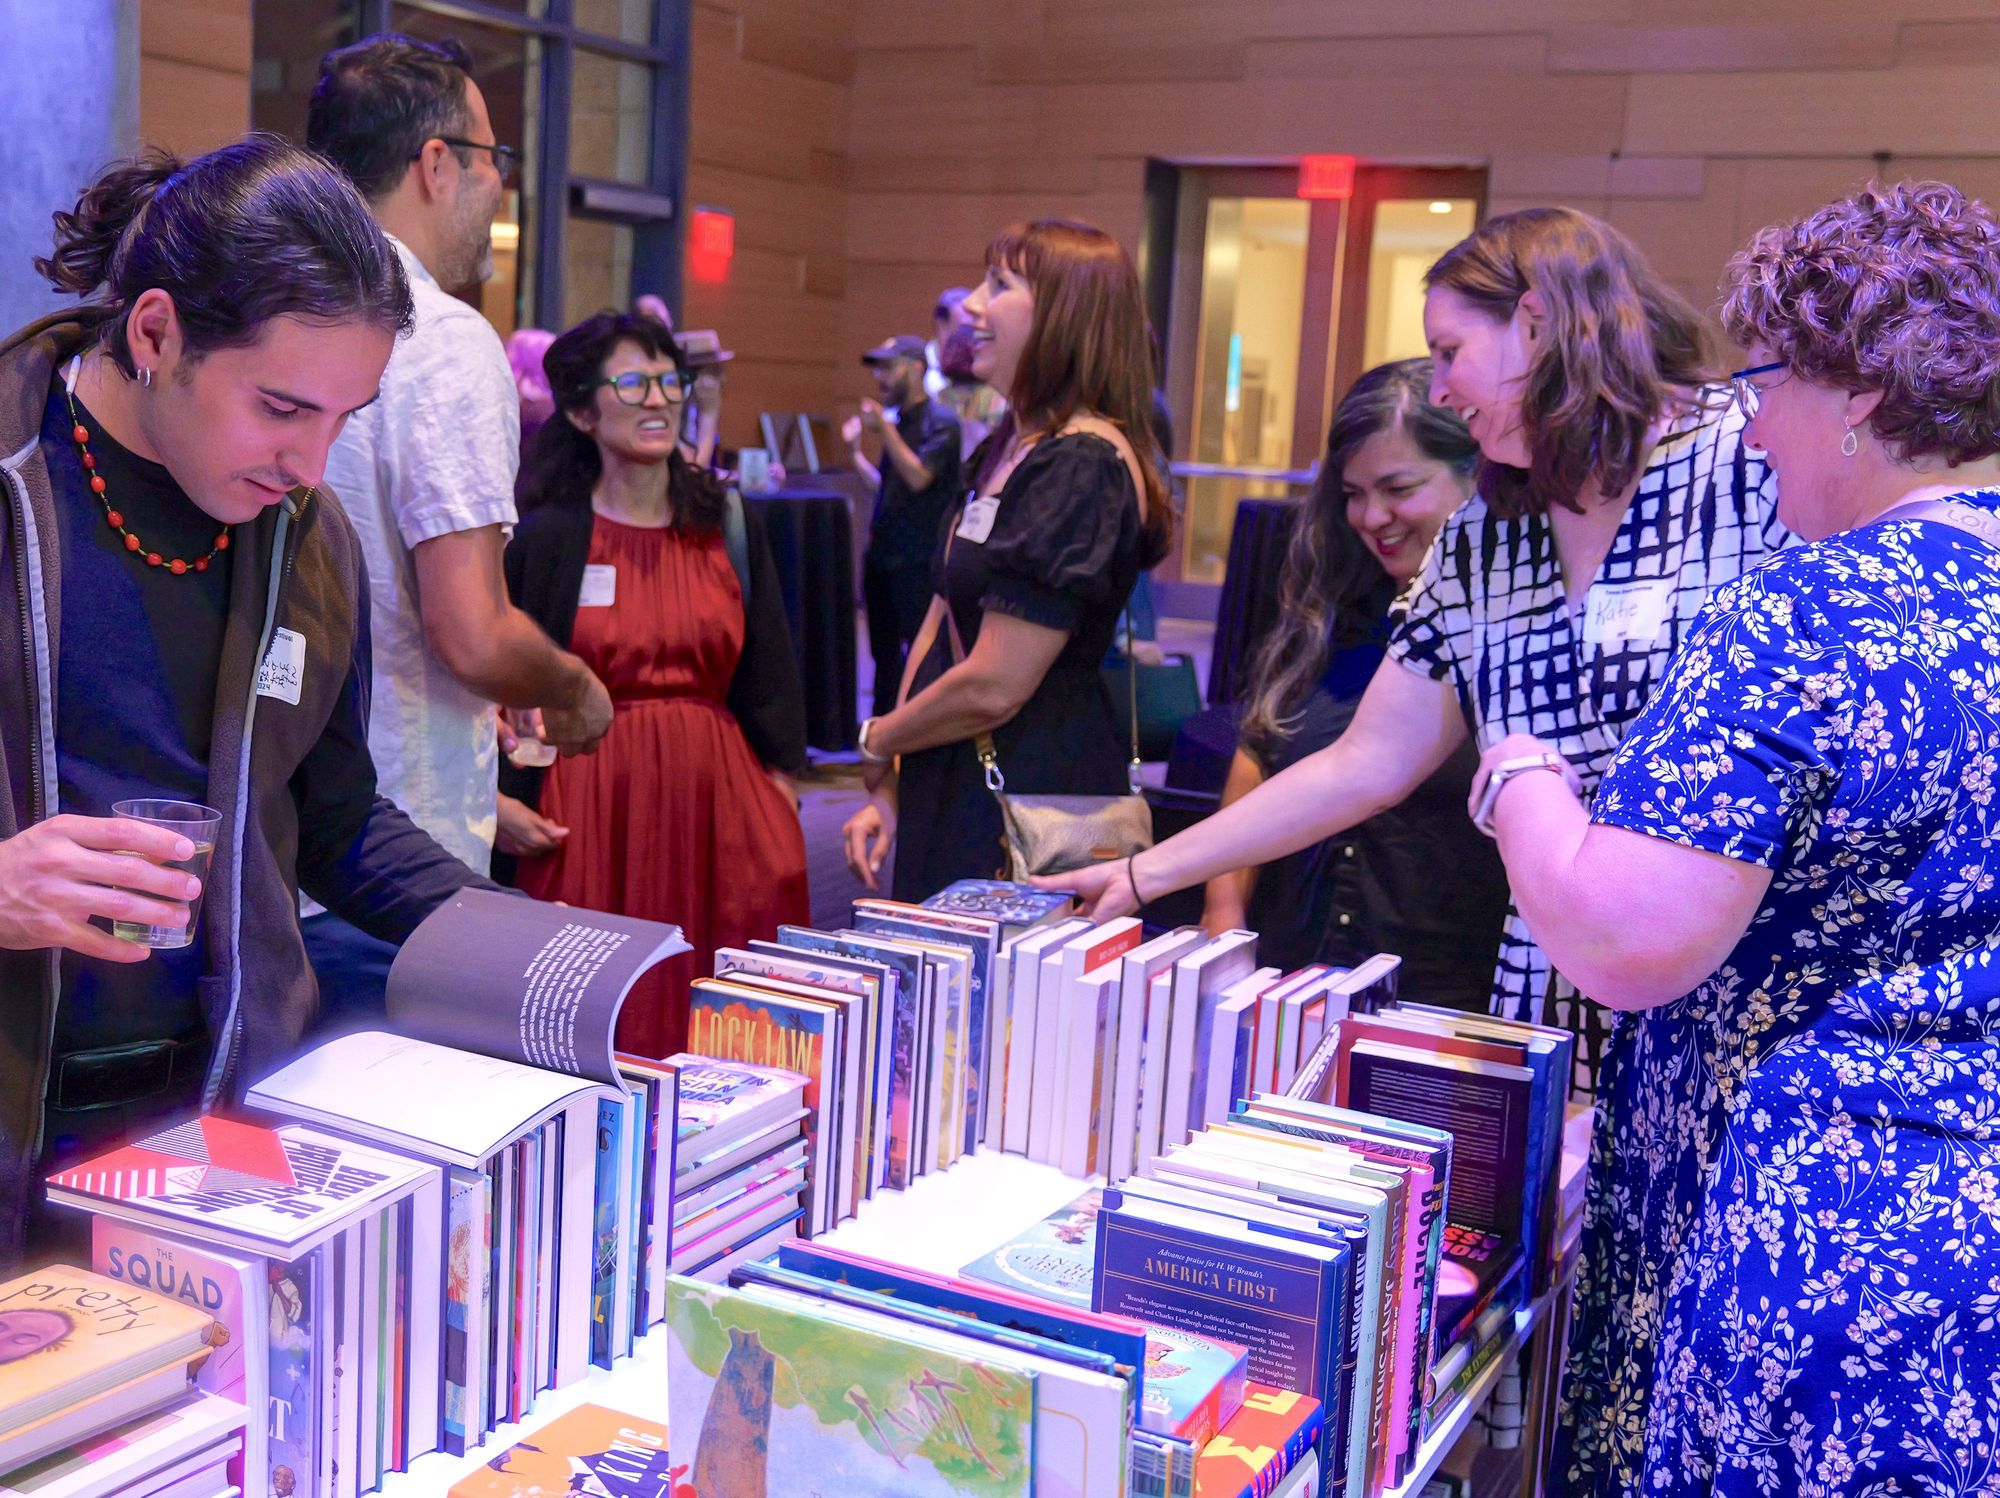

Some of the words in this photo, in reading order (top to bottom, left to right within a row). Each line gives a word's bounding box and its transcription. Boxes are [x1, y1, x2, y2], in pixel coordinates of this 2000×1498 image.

[1595, 598, 1638, 626] Katie
[528, 972, 541, 989] more
[539, 973, 551, 987] that
[581, 971, 597, 988] know
[523, 989, 532, 1006] than
[534, 988, 544, 1000] has
[542, 987, 553, 1007] equal
[552, 982, 568, 1010] because
[561, 993, 573, 1009] they
[573, 989, 585, 1004] why
[530, 1001, 539, 1022] fallen
[540, 1008, 547, 1017] to
[550, 1012, 556, 1020] us
[568, 1005, 578, 1022] they
[558, 1013, 566, 1042] oppress
[540, 1040, 545, 1050] An
[548, 1028, 556, 1055] greater
[693, 1008, 814, 1076] LOCKJAW
[542, 1051, 552, 1067] equal
[552, 1056, 561, 1069] than
[680, 1079, 739, 1094] SIAN
[681, 1068, 741, 1082] ADE
[741, 1076, 772, 1087] IN
[679, 1089, 736, 1105] RICA
[318, 1165, 391, 1200] BOOK
[262, 1199, 325, 1220] OF
[1413, 1192, 1432, 1289] DOCILE
[157, 1247, 173, 1261] THE
[1158, 1249, 1185, 1260] Advance
[1185, 1256, 1205, 1265] praise
[1204, 1259, 1215, 1268] for
[1216, 1262, 1225, 1270] H.
[1226, 1264, 1235, 1273] W.
[1236, 1267, 1263, 1279] Brands's
[108, 1246, 223, 1310] SQUAD
[1144, 1257, 1220, 1289] AMERICA
[1228, 1277, 1278, 1303] FIRST
[3, 1281, 158, 1336] pretty
[1380, 1279, 1395, 1346] JANE
[1120, 1302, 1144, 1313] Roosevelt
[1155, 1310, 1174, 1320] Charles
[1175, 1316, 1201, 1328] Lindbergh
[1202, 1323, 1217, 1331] could
[1227, 1328, 1235, 1336] be
[1249, 1335, 1266, 1345] timely.
[1269, 1339, 1280, 1347] This
[1281, 1342, 1295, 1351] book
[1148, 1300, 1166, 1309] elegant
[1167, 1304, 1186, 1313] account
[1203, 1314, 1224, 1323] political
[1225, 1319, 1245, 1328] face-off
[1245, 1323, 1267, 1333] between
[1268, 1328, 1291, 1339] Franklin
[1268, 1350, 1293, 1360] tenacious
[1258, 1357, 1274, 1366] States
[1284, 1364, 1297, 1372] away
[1265, 1368, 1283, 1378] insight
[1284, 1373, 1296, 1381] into
[1277, 1382, 1296, 1391] today's
[1347, 1388, 1355, 1436] Generations
[595, 1427, 664, 1483] KING
